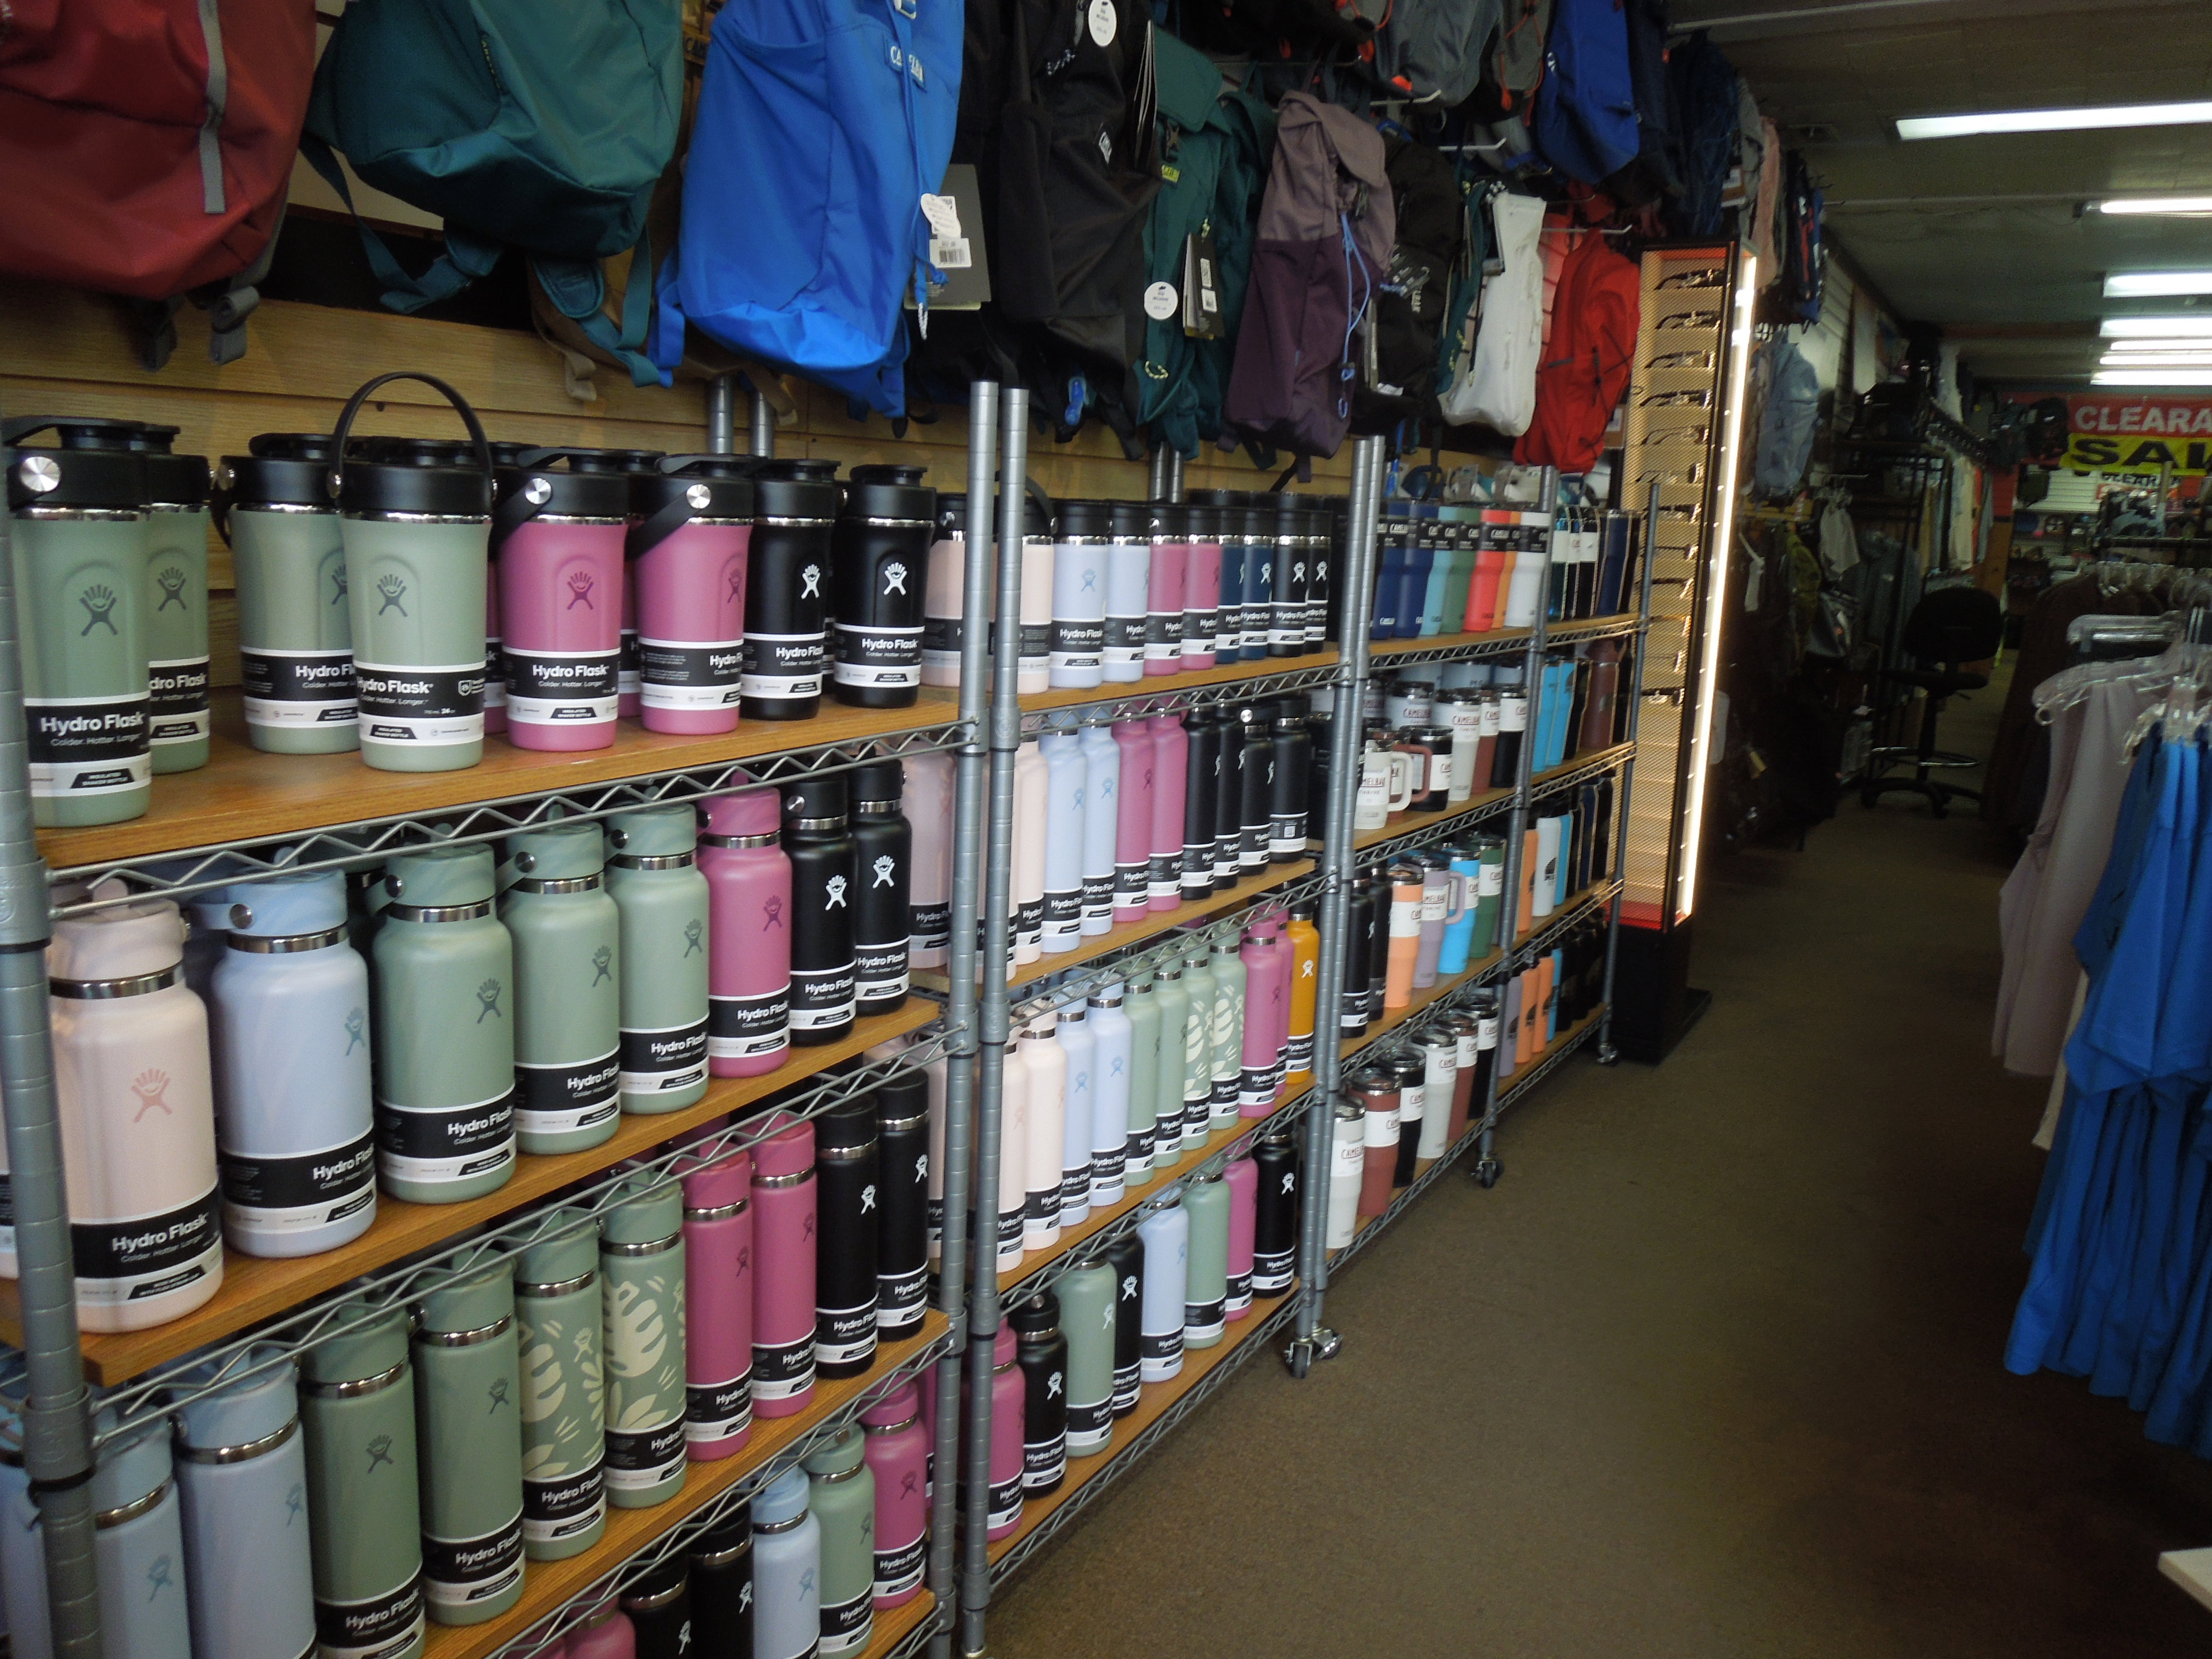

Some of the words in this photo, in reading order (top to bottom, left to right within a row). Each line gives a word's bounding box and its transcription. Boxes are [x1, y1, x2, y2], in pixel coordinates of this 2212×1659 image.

[1060, 628, 1086, 639] Hydro
[862, 638, 894, 651] Hydro
[895, 638, 917, 649] Flask
[776, 647, 806, 660] Hydro
[296, 665, 339, 681] Hydro
[532, 664, 573, 680] Hydro
[576, 664, 607, 677] Flask
[177, 673, 206, 688] Flask
[357, 676, 386, 692] Hydro
[387, 680, 430, 694] Flask
[40, 717, 102, 736] Hydro
[104, 711, 145, 729] Flask
[1051, 898, 1073, 909] Hydro
[916, 912, 940, 923] Hydro
[857, 957, 886, 968] Hydro
[887, 951, 906, 964] Flask
[805, 982, 835, 996] Hydro
[836, 976, 854, 990] Flask
[737, 1008, 769, 1022] Hydro
[651, 1041, 685, 1056] Hydro
[567, 1073, 602, 1091] Hydro
[447, 1119, 489, 1137] Hydro
[313, 1160, 354, 1181] Hydro
[112, 1232, 167, 1254] Hydro
[169, 1213, 209, 1239] Flask
[834, 1318, 863, 1331] Hydro
[541, 1487, 580, 1504] Hydro
[456, 1548, 496, 1566] Hydro
[346, 1610, 389, 1630] Hydro
